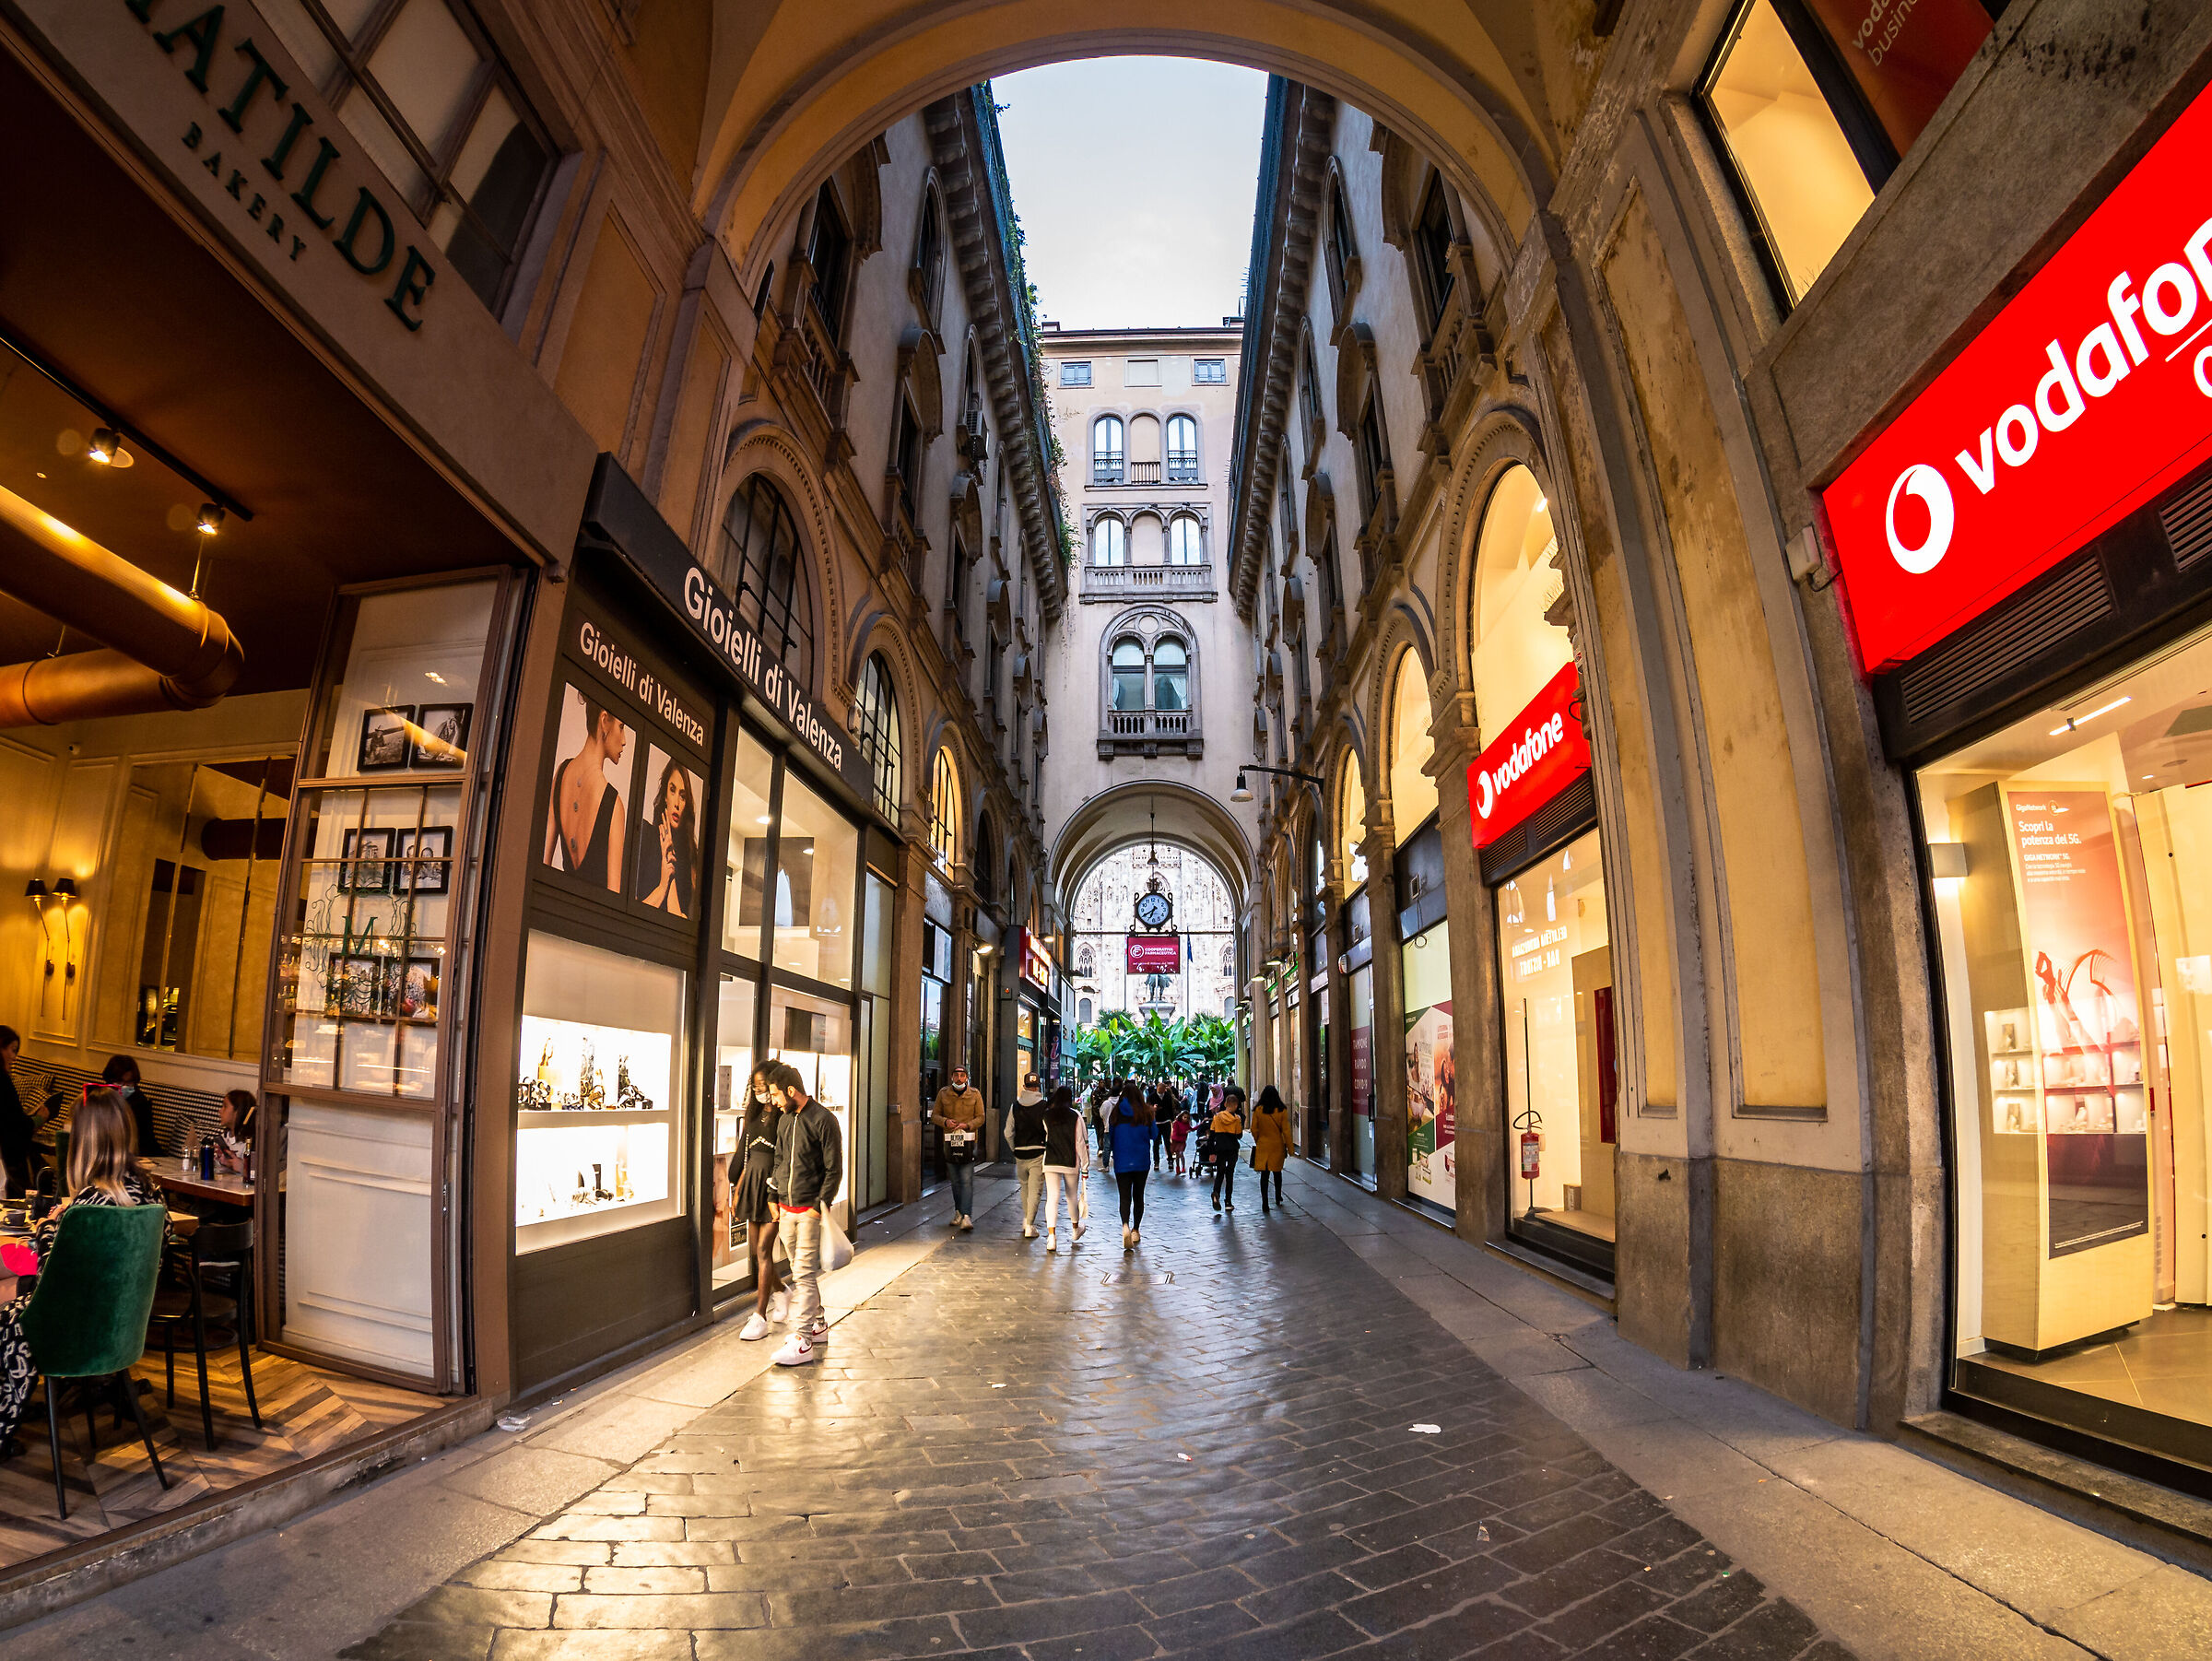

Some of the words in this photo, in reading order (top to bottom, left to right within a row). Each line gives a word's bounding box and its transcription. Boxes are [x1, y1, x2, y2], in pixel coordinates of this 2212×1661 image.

[124, 0, 436, 332] ATILDE
[182, 122, 306, 262] BAKERY
[580, 621, 637, 691] Gioielli
[639, 674, 654, 705] di
[657, 683, 704, 747] Valenza
[684, 567, 762, 685] Gioielli
[765, 664, 783, 709] di
[788, 679, 842, 772] Valenza
[1492, 713, 1564, 795] vodafone
[2018, 820, 2044, 834] Scopri
[2045, 820, 2053, 831] la
[2021, 835, 2053, 848] potenza
[2054, 834, 2067, 844] del
[2068, 833, 2082, 844] 5G.
[342, 915, 378, 957] M
